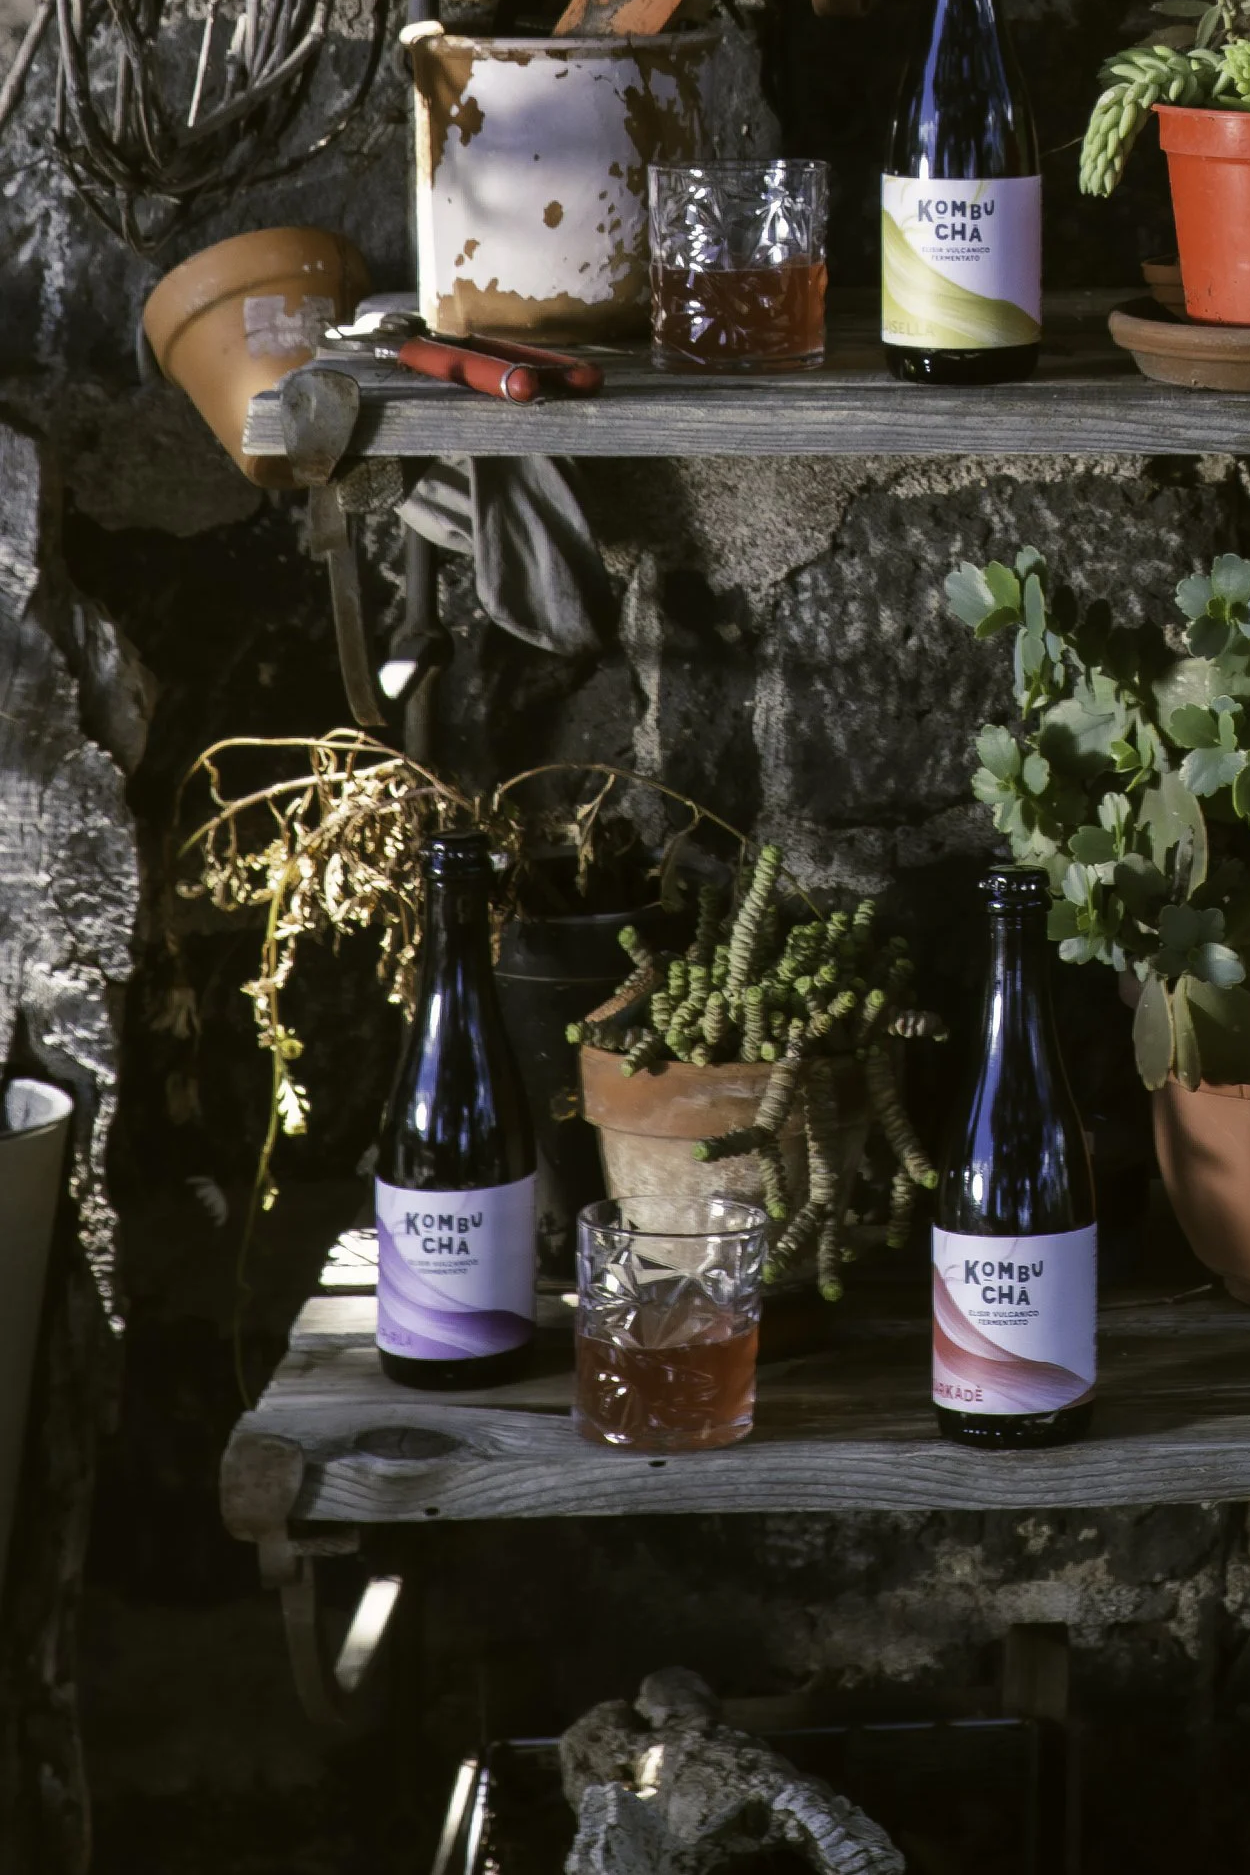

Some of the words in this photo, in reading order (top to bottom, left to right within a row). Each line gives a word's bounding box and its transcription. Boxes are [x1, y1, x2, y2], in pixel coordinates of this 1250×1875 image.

[918, 199, 995, 222] KOMBU
[405, 1211, 483, 1236] KOMBU
[964, 1260, 1043, 1285] KOMBU
